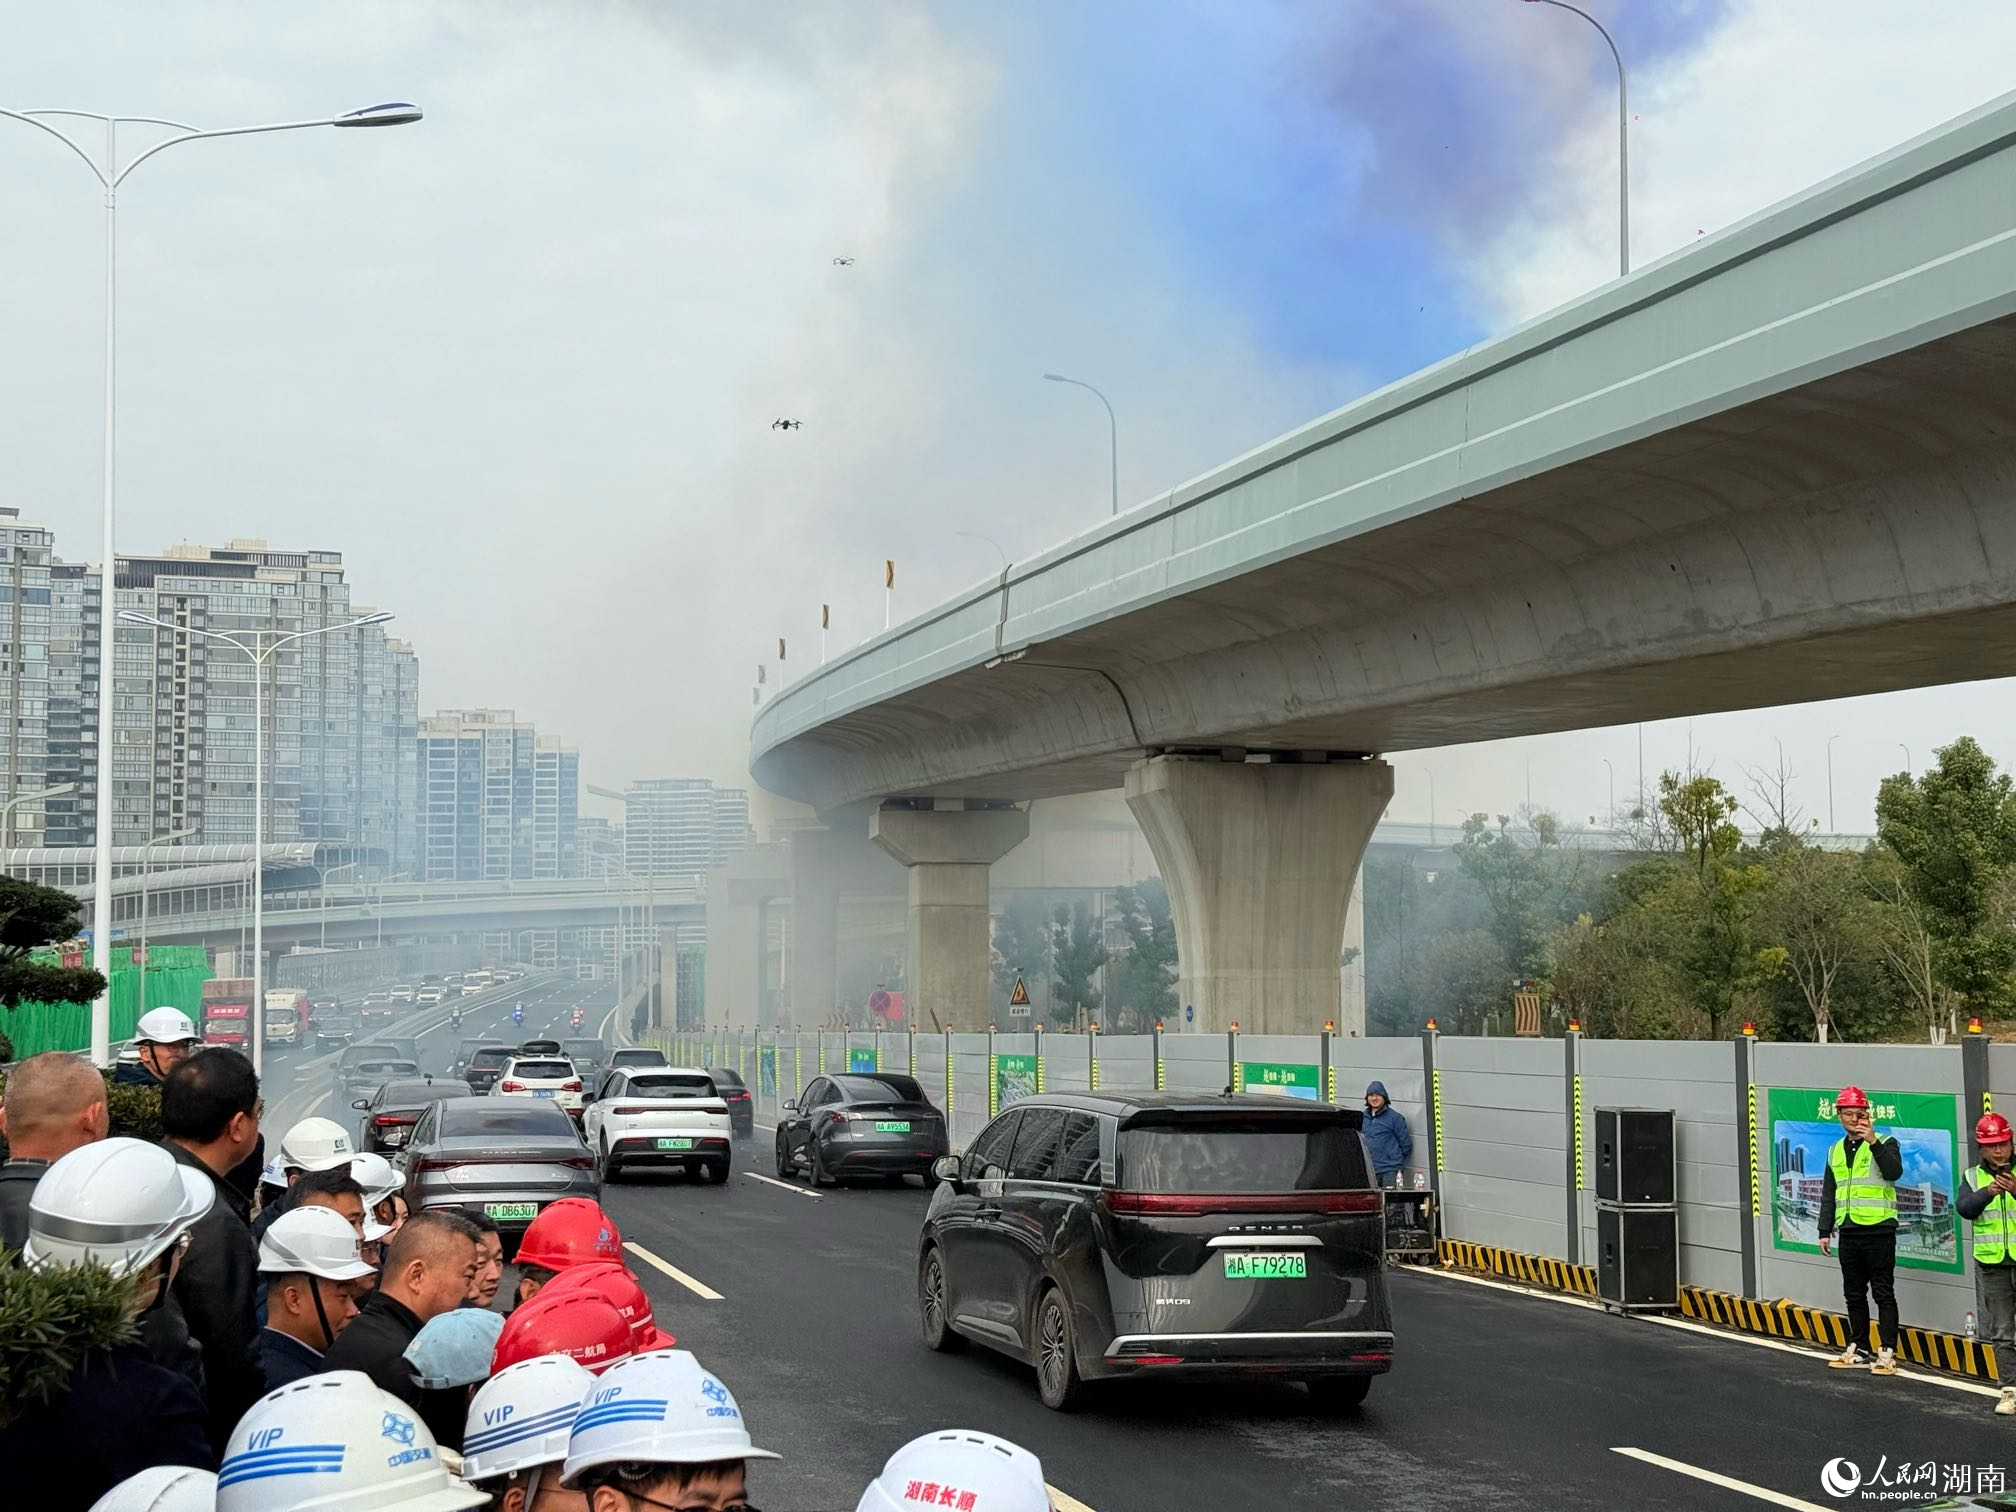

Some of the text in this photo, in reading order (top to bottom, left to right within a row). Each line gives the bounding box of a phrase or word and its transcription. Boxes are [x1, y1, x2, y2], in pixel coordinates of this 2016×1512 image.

[594, 1386, 623, 1405] VIP
[484, 1405, 514, 1427] VIP
[248, 1427, 284, 1451] VIP
[904, 1480, 978, 1512] 湖南长顺
